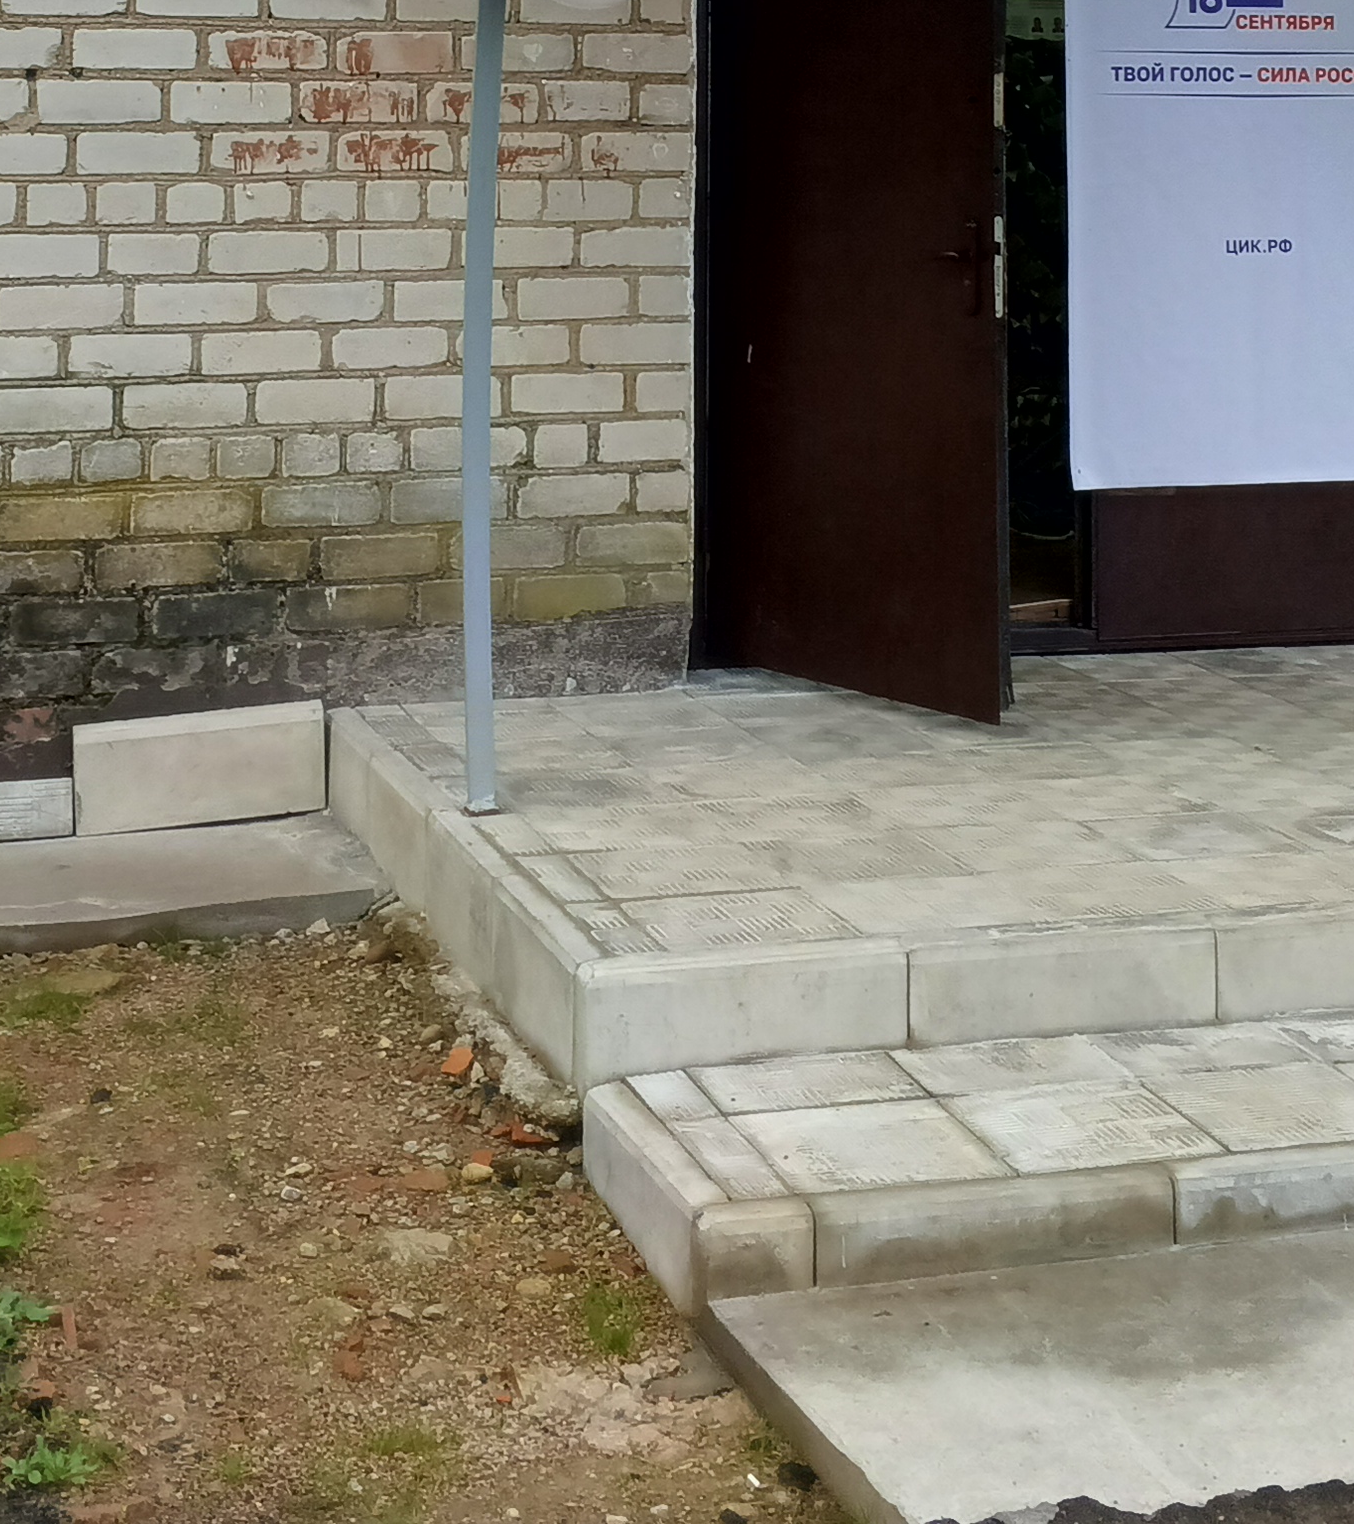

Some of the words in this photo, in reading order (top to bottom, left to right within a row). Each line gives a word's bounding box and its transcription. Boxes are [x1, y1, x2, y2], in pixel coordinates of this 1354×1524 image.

[1235, 14, 1335, 30] СЕНТЯБРЯ
[1111, 63, 1165, 82] ТВОЙ
[1170, 66, 1235, 82] ГОЛОС
[1257, 67, 1310, 83] СИЛА
[1226, 238, 1292, 255] ЦИК.РФ
